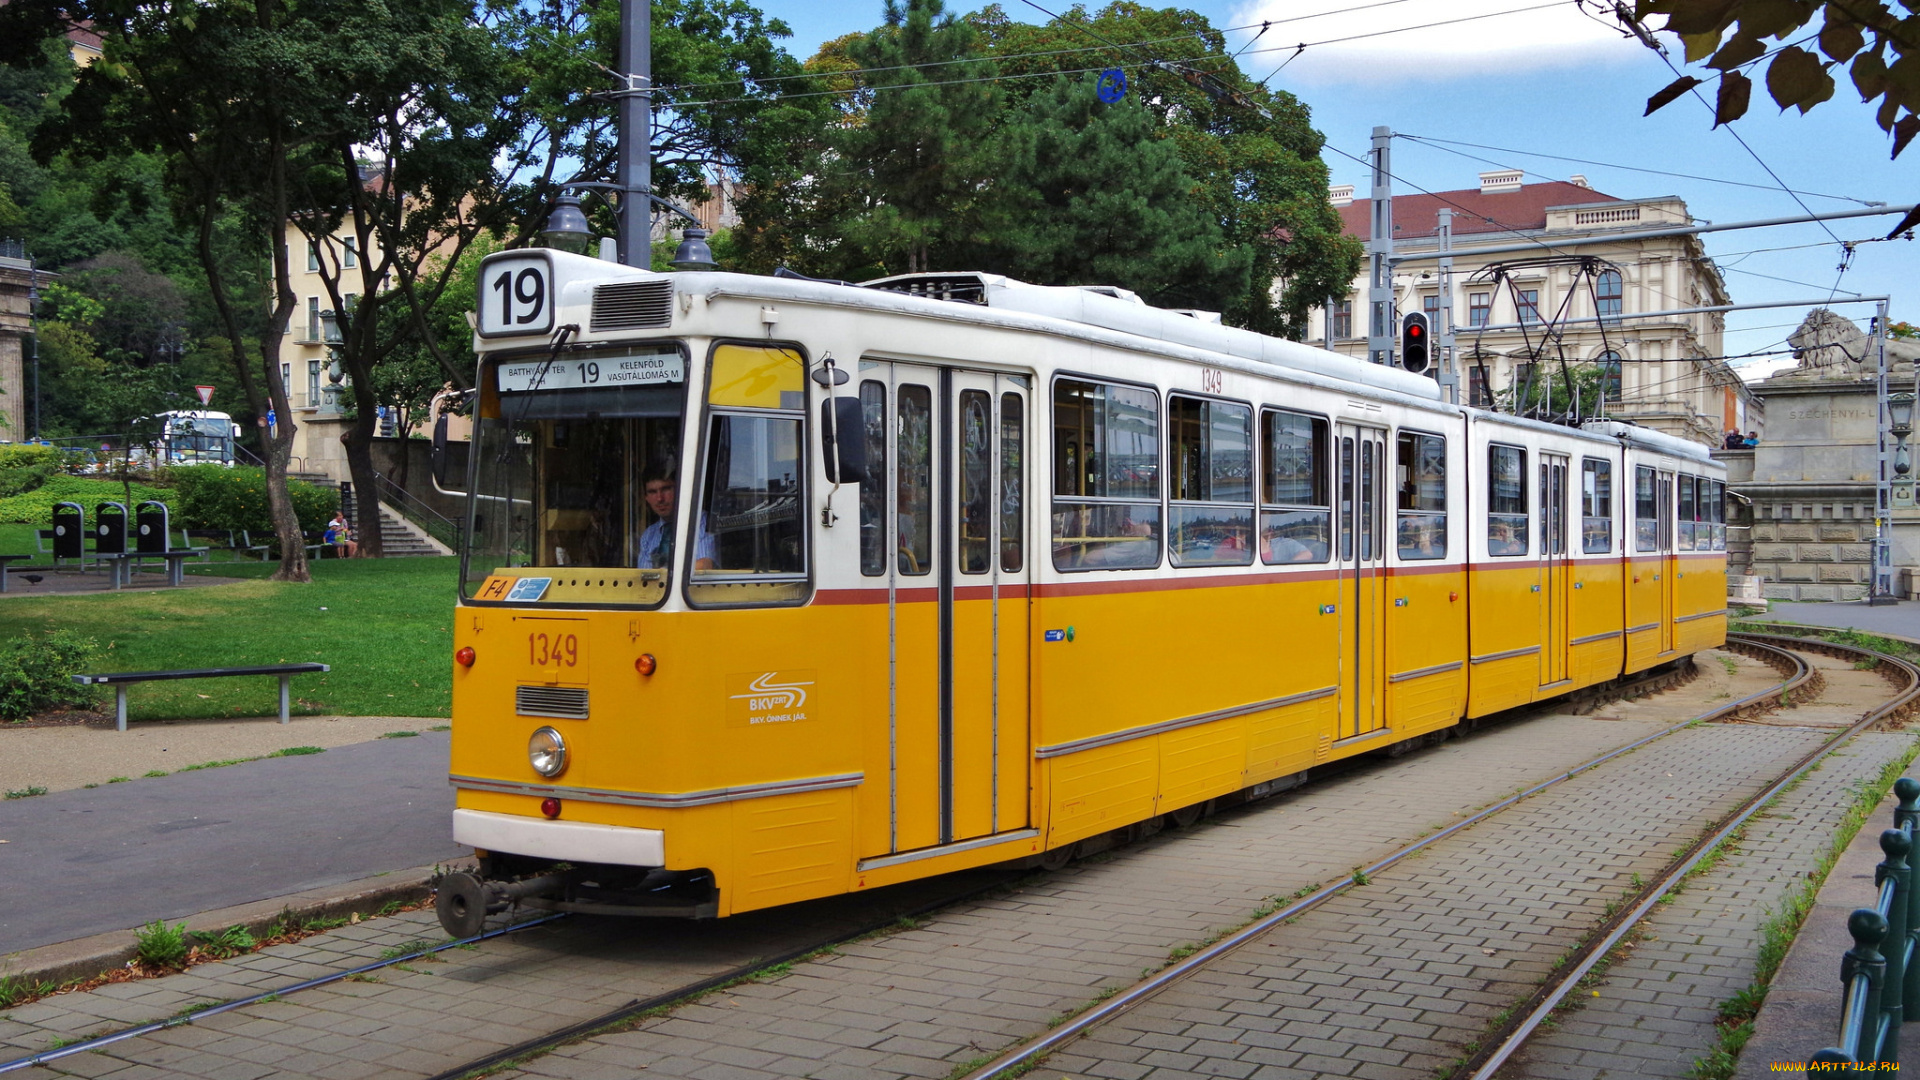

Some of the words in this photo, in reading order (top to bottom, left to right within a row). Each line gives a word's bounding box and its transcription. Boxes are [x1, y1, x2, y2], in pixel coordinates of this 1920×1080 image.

[493, 267, 545, 326] 19
[552, 364, 566, 374] TÉR
[577, 362, 600, 384] 19
[620, 359, 664, 371] KELENFÖLD
[607, 370, 669, 382] VASÚTÁLLOMÁS
[671, 369, 679, 378] M
[1202, 367, 1222, 394] 1349
[483, 579, 508, 598] F4
[529, 632, 578, 668] 1349
[749, 697, 774, 711] BKV
[766, 713, 792, 723] ÖNNEK
[793, 711, 807, 723] JÁR.
